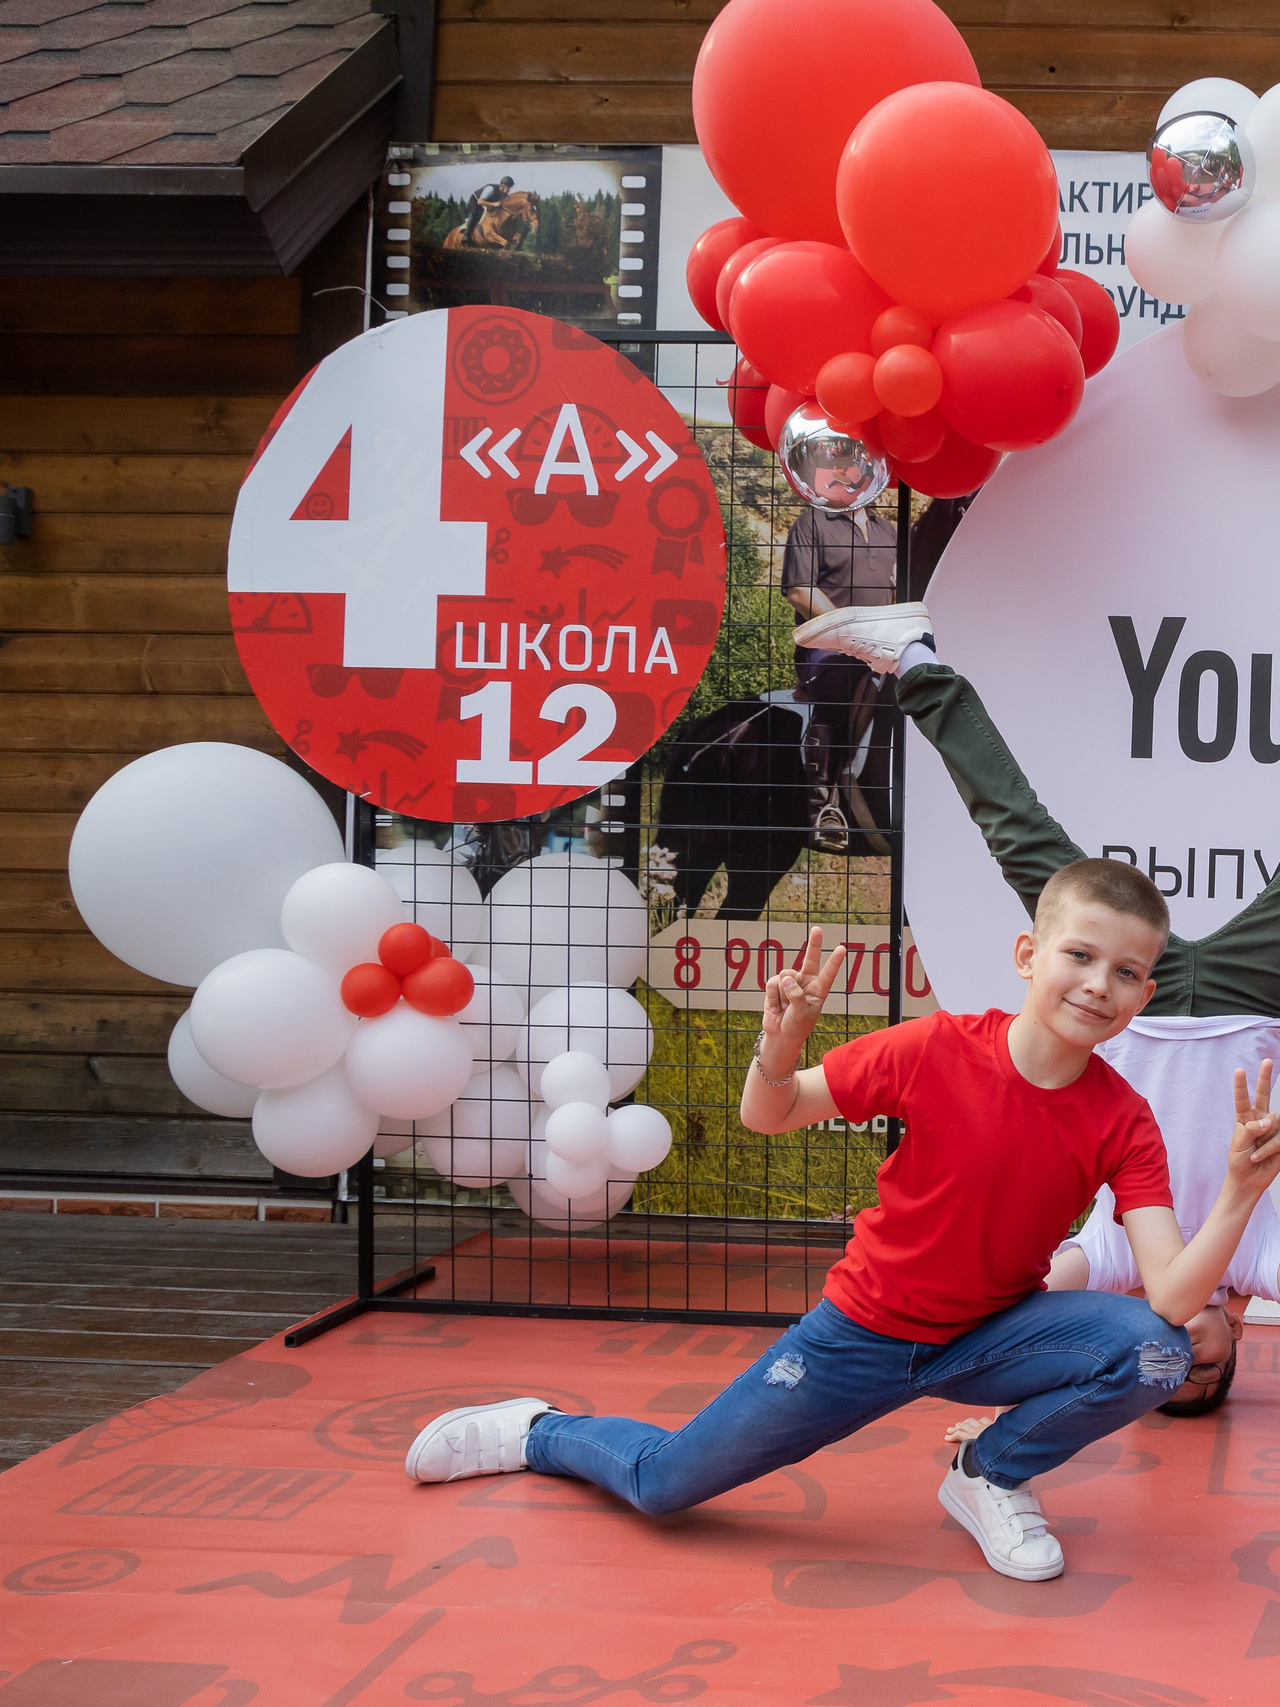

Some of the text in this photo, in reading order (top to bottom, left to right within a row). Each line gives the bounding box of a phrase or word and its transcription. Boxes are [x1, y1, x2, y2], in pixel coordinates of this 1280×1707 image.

[227, 308, 487, 669] 4
[454, 621, 679, 675] ШКОЛА
[456, 681, 635, 787] 12
[673, 936, 702, 990] 8
